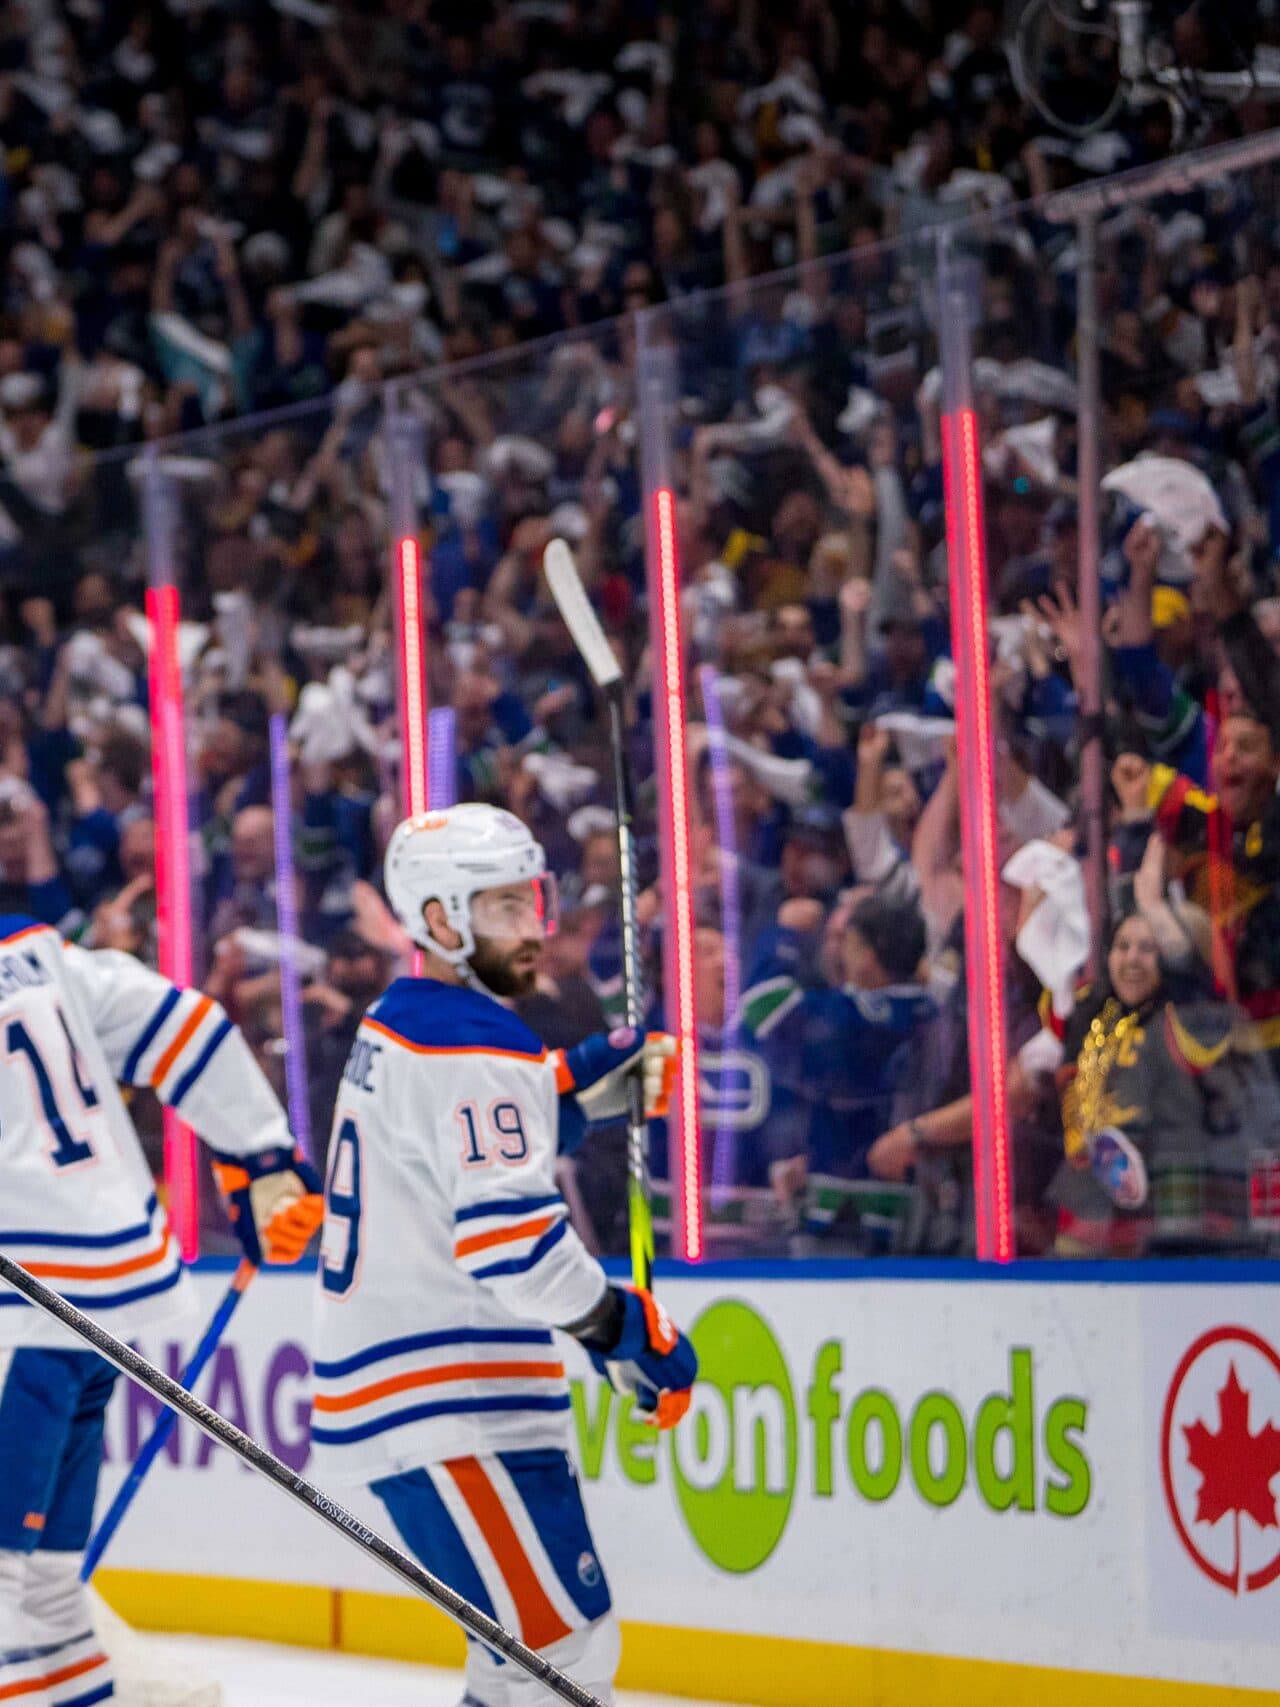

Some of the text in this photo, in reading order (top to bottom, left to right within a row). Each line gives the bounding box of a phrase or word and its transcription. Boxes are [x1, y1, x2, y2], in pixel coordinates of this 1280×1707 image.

[455, 1098, 532, 1169] 19
[674, 1380, 789, 1495] on
[807, 1338, 1093, 1517] foods
[313, 1494, 375, 1545] PETTERSSON
